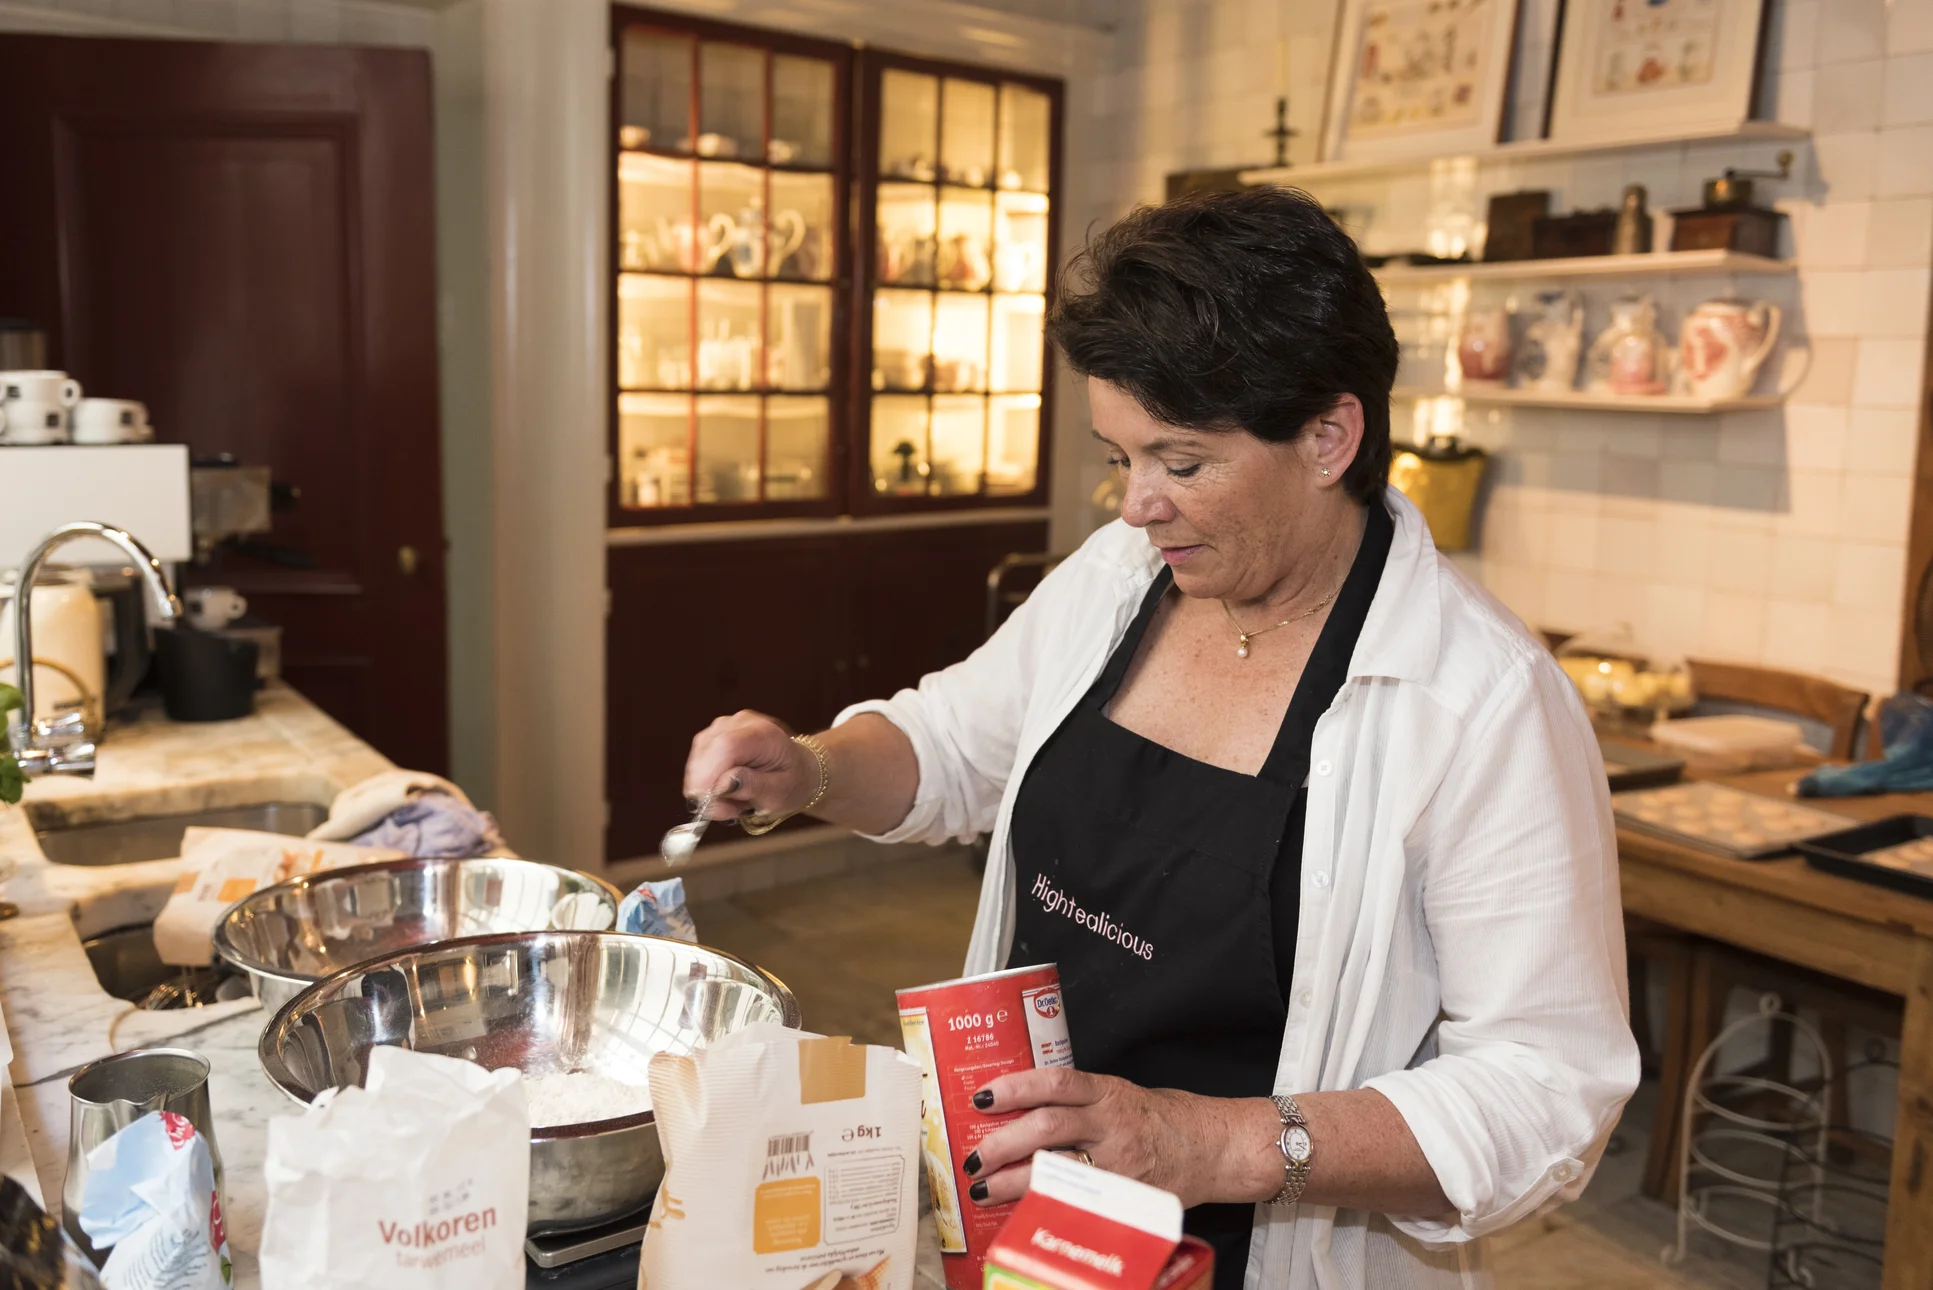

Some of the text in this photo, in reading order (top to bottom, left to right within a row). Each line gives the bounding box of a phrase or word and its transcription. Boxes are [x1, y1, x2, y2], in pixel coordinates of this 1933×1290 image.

[1031, 872, 1154, 960] Hightealicious
[947, 1014, 981, 1031] 1000
[985, 1014, 994, 1028] g
[973, 1033, 994, 1043] 16786
[378, 1207, 497, 1248] Volkoren
[396, 1234, 487, 1269] tarwemeel
[1030, 1227, 1125, 1278] Karnemelk
